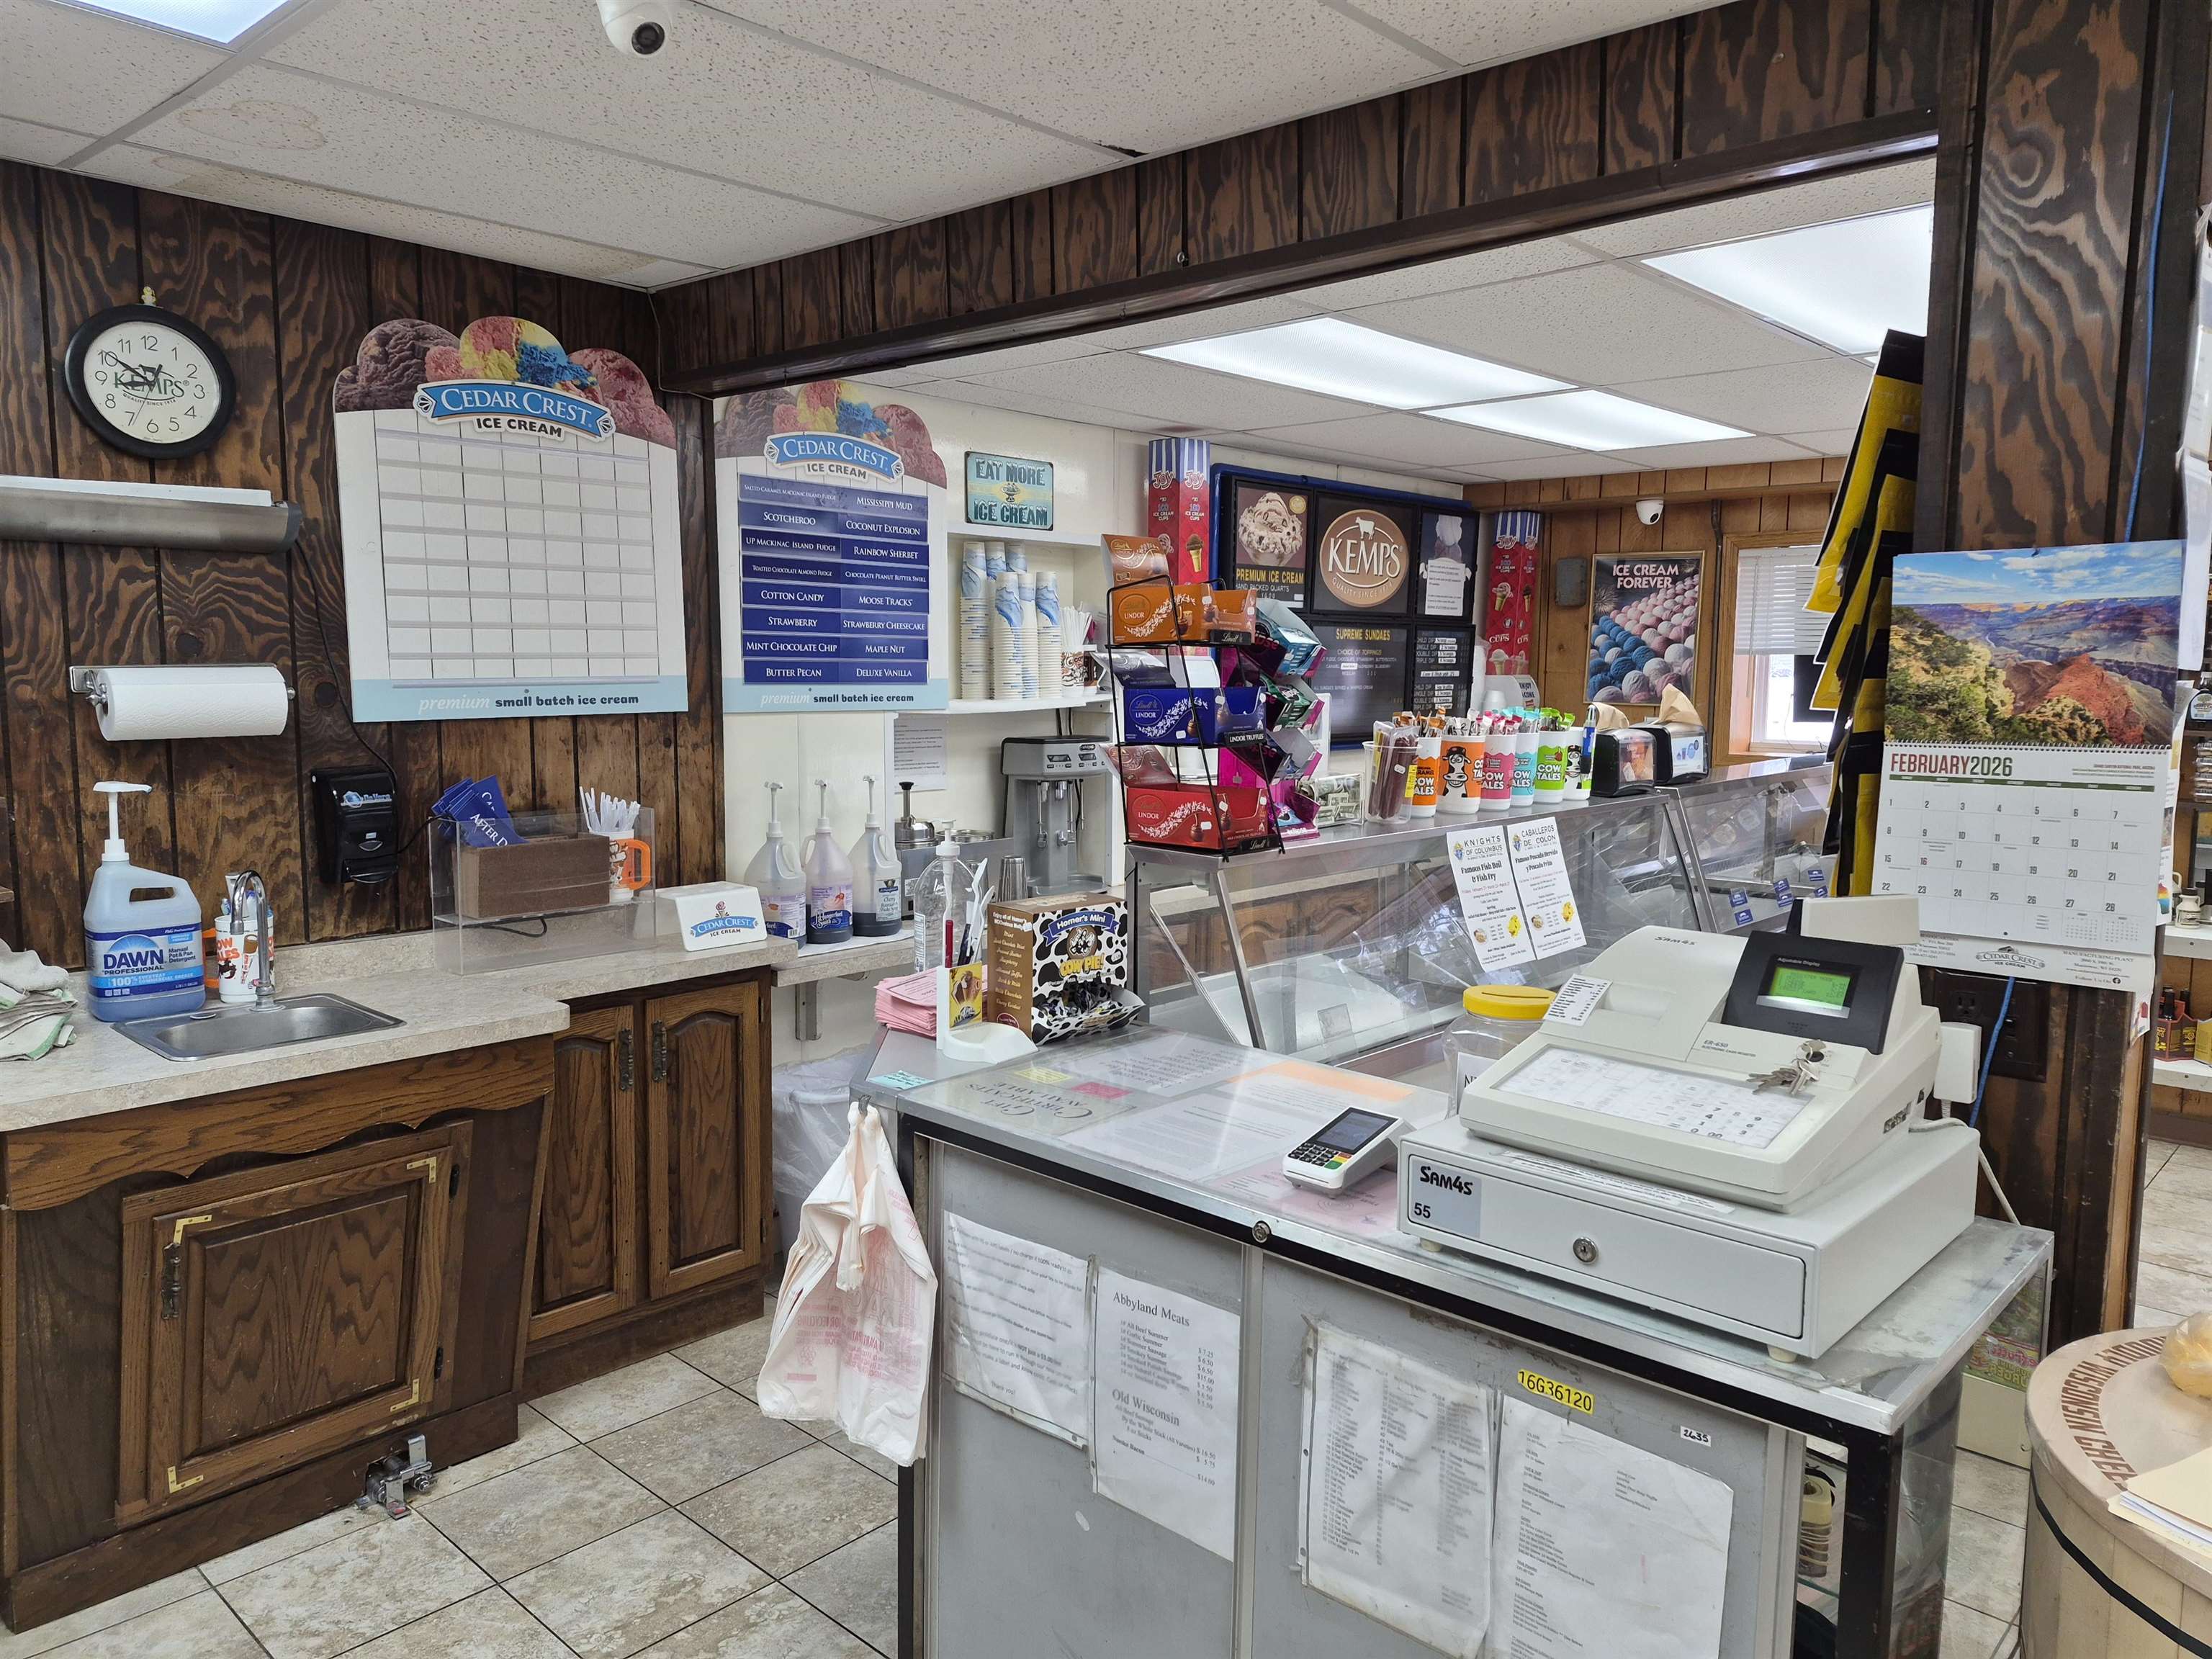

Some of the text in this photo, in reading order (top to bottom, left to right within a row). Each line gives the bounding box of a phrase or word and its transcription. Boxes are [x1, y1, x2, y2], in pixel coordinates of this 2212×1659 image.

[117, 338, 131, 354] 11
[140, 335, 158, 351] 12
[98, 350, 117, 367] 10
[94, 371, 107, 385] 9
[186, 363, 197, 379] 2
[193, 385, 205, 399] 3
[105, 394, 116, 408] 8
[441, 388, 592, 426] CEDAR CREST
[125, 411, 135, 426] 7
[184, 405, 197, 418] 4
[146, 419, 158, 433] 6
[168, 417, 179, 431] 5
[477, 418, 562, 438] ICE CREAM
[783, 439, 889, 469] CEDAR CREST
[806, 463, 866, 480] ICE CREAM
[976, 459, 1046, 486] EAT MORE
[857, 497, 912, 511] MISSISSIPPI MUD
[763, 511, 816, 526] SCOTCHEROO
[974, 500, 1048, 526] ICE CREAM
[845, 521, 920, 536] COCONUT EXPLOSION
[756, 538, 790, 548] MACKINAC
[792, 541, 814, 550] ISLAND
[816, 544, 836, 552] FUDGE
[854, 547, 918, 559] RAINBOW SHERBET
[1328, 537, 1401, 578] KEMPS
[1236, 568, 1304, 584] PREMIUM ICE CREAM
[1612, 565, 1678, 576] ICE CREAM
[1332, 577, 1357, 597] QUALITY
[1358, 590, 1377, 598] SINCE
[1617, 577, 1673, 588] FOREVER
[760, 590, 824, 602] COTTON CANDY
[859, 596, 913, 606] MOOSE TRACKS
[768, 616, 817, 627] STRAWBERRY
[843, 620, 925, 631] STRAWBERRY CHEESECAKE
[1336, 629, 1390, 641] SUPREME SUNDAES
[747, 642, 837, 653] MINT CHOCOLATE CHIP
[890, 645, 905, 654] NUT
[766, 668, 822, 677] BUTTER PECAN
[856, 668, 912, 677] DELUXE VANILLA
[418, 694, 639, 715] premium small batch ice cream
[760, 691, 914, 706] premium small batch ice cream
[469, 812, 503, 843] AFTER
[1521, 824, 1555, 837] CABALLEROS
[1464, 835, 1501, 847] KNIGHTS
[1922, 829, 1927, 837] 9
[1959, 831, 1965, 840] 10
[2071, 839, 2079, 848] 13
[2110, 842, 2118, 850] 14
[1461, 860, 1502, 874] Famous Fish Boil
[1884, 855, 2116, 881] 15 16 17 18 19 20 21
[697, 917, 750, 933] CEDAR CREST
[1057, 914, 1106, 930] Homer's Mini
[104, 950, 164, 969] DAWN
[1060, 953, 1106, 977] COW PIE!
[1983, 953, 2036, 966] CEDAR CREST
[104, 966, 164, 975] PROFESSIONAL
[967, 1084, 1093, 1119] CERTIFICATES
[993, 1082, 1080, 1107] AVAILABLE
[981, 1100, 1035, 1116] GIFT
[1413, 1202, 1431, 1219] 55
[1113, 1292, 1190, 1327] Abbyland Meats
[1202, 1349, 1213, 1358] 7.25
[991, 1380, 1004, 1390] Thank
[2061, 1360, 2118, 1435] WISCONSIN
[1112, 1388, 1180, 1426] Old Wisconsin
[1130, 1443, 1145, 1455] Bacon
